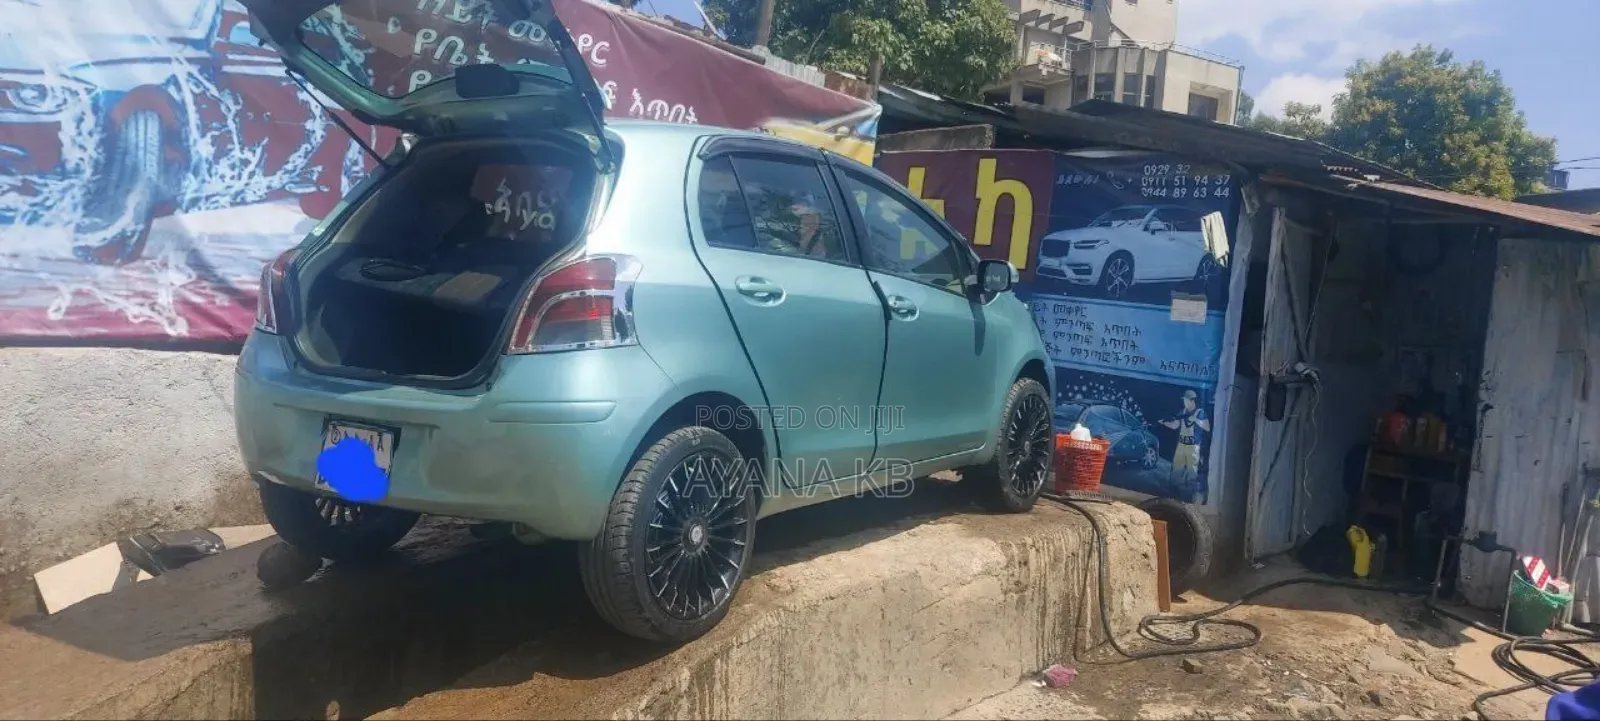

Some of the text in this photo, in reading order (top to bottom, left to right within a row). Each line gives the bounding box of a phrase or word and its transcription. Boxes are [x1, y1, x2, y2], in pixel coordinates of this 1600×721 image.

[629, 87, 699, 124] እጥበት
[1144, 164, 1170, 176] 0929
[1141, 174, 1230, 187] 0911 51 94 37
[1141, 187, 1230, 198] 0944 89 63 44
